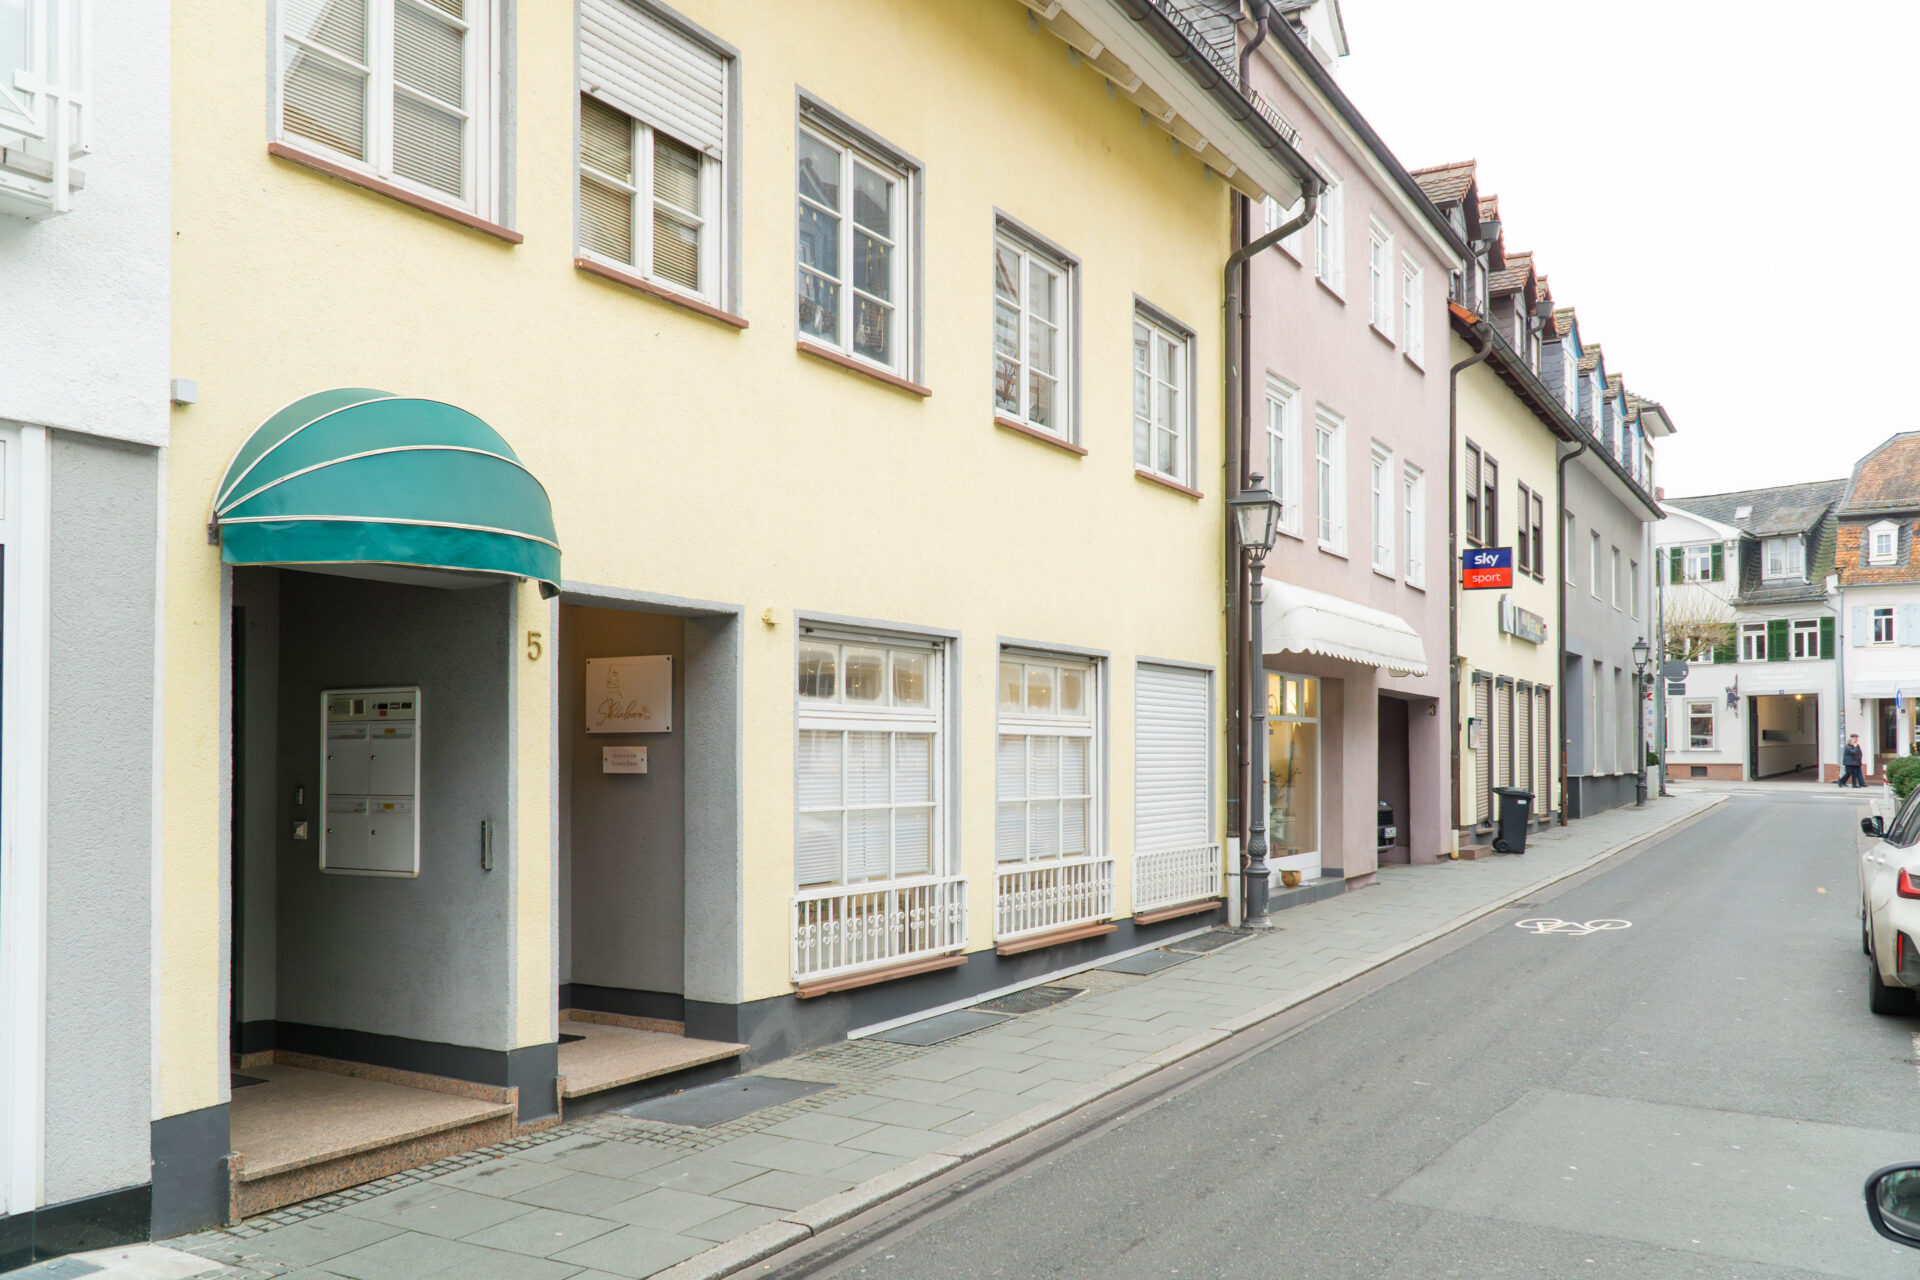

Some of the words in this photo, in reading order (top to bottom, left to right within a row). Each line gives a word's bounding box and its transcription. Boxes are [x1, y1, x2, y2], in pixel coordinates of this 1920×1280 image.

[1474, 552, 1499, 567] sky
[1472, 573, 1501, 584] sport
[527, 630, 542, 662] 5
[1429, 704, 1437, 716] 3
